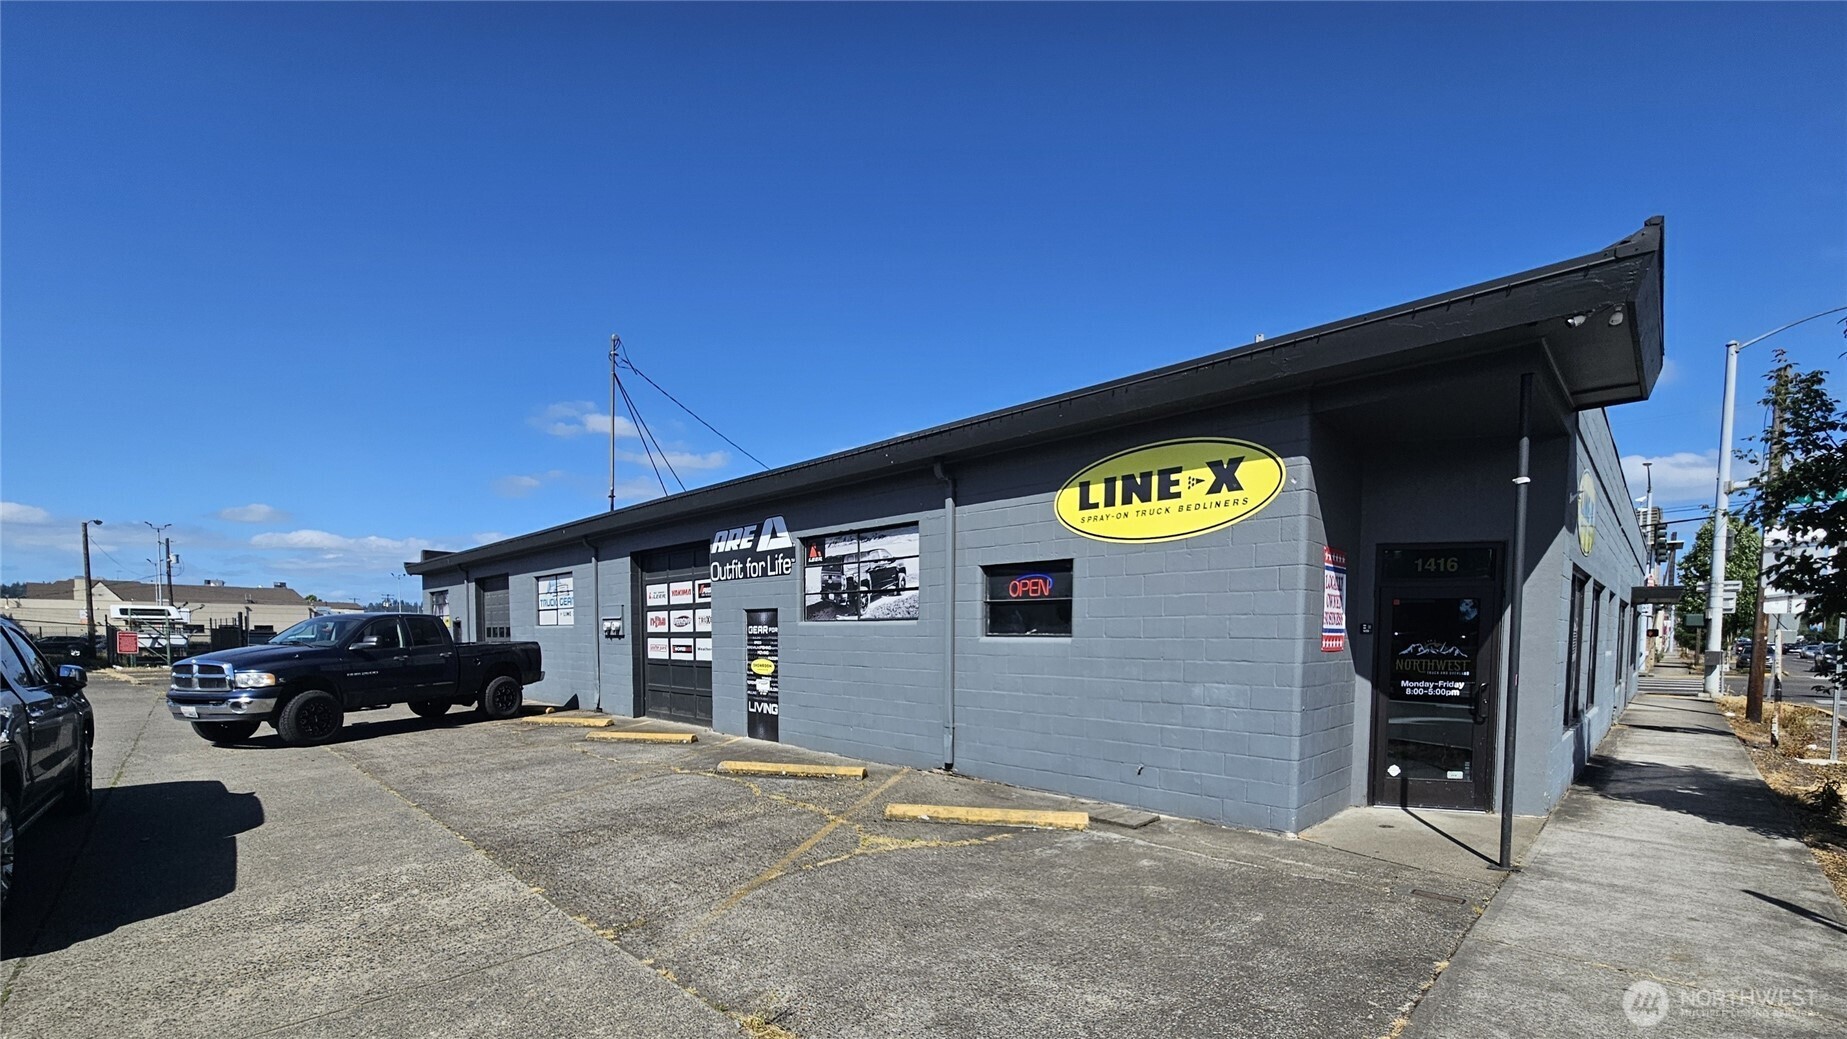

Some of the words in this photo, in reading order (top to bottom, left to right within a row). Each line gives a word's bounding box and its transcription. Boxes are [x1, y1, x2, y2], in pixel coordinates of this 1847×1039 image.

[1080, 511, 1130, 524] SPRAY-ON
[1135, 506, 1172, 517] TRUCK
[1177, 497, 1250, 513] BEDLINERS
[711, 525, 758, 554] ARE
[711, 558, 744, 582] Outfit
[745, 557, 766, 578] for
[1414, 557, 1459, 572] 1416
[1009, 579, 1050, 598] OPEN
[748, 625, 769, 635] GEAR
[1395, 658, 1472, 673] NORTHWEST
[1400, 680, 1466, 690] Monday-Friday
[1405, 687, 1460, 697] 8:00-5:00pm
[748, 700, 779, 716] LIVING
